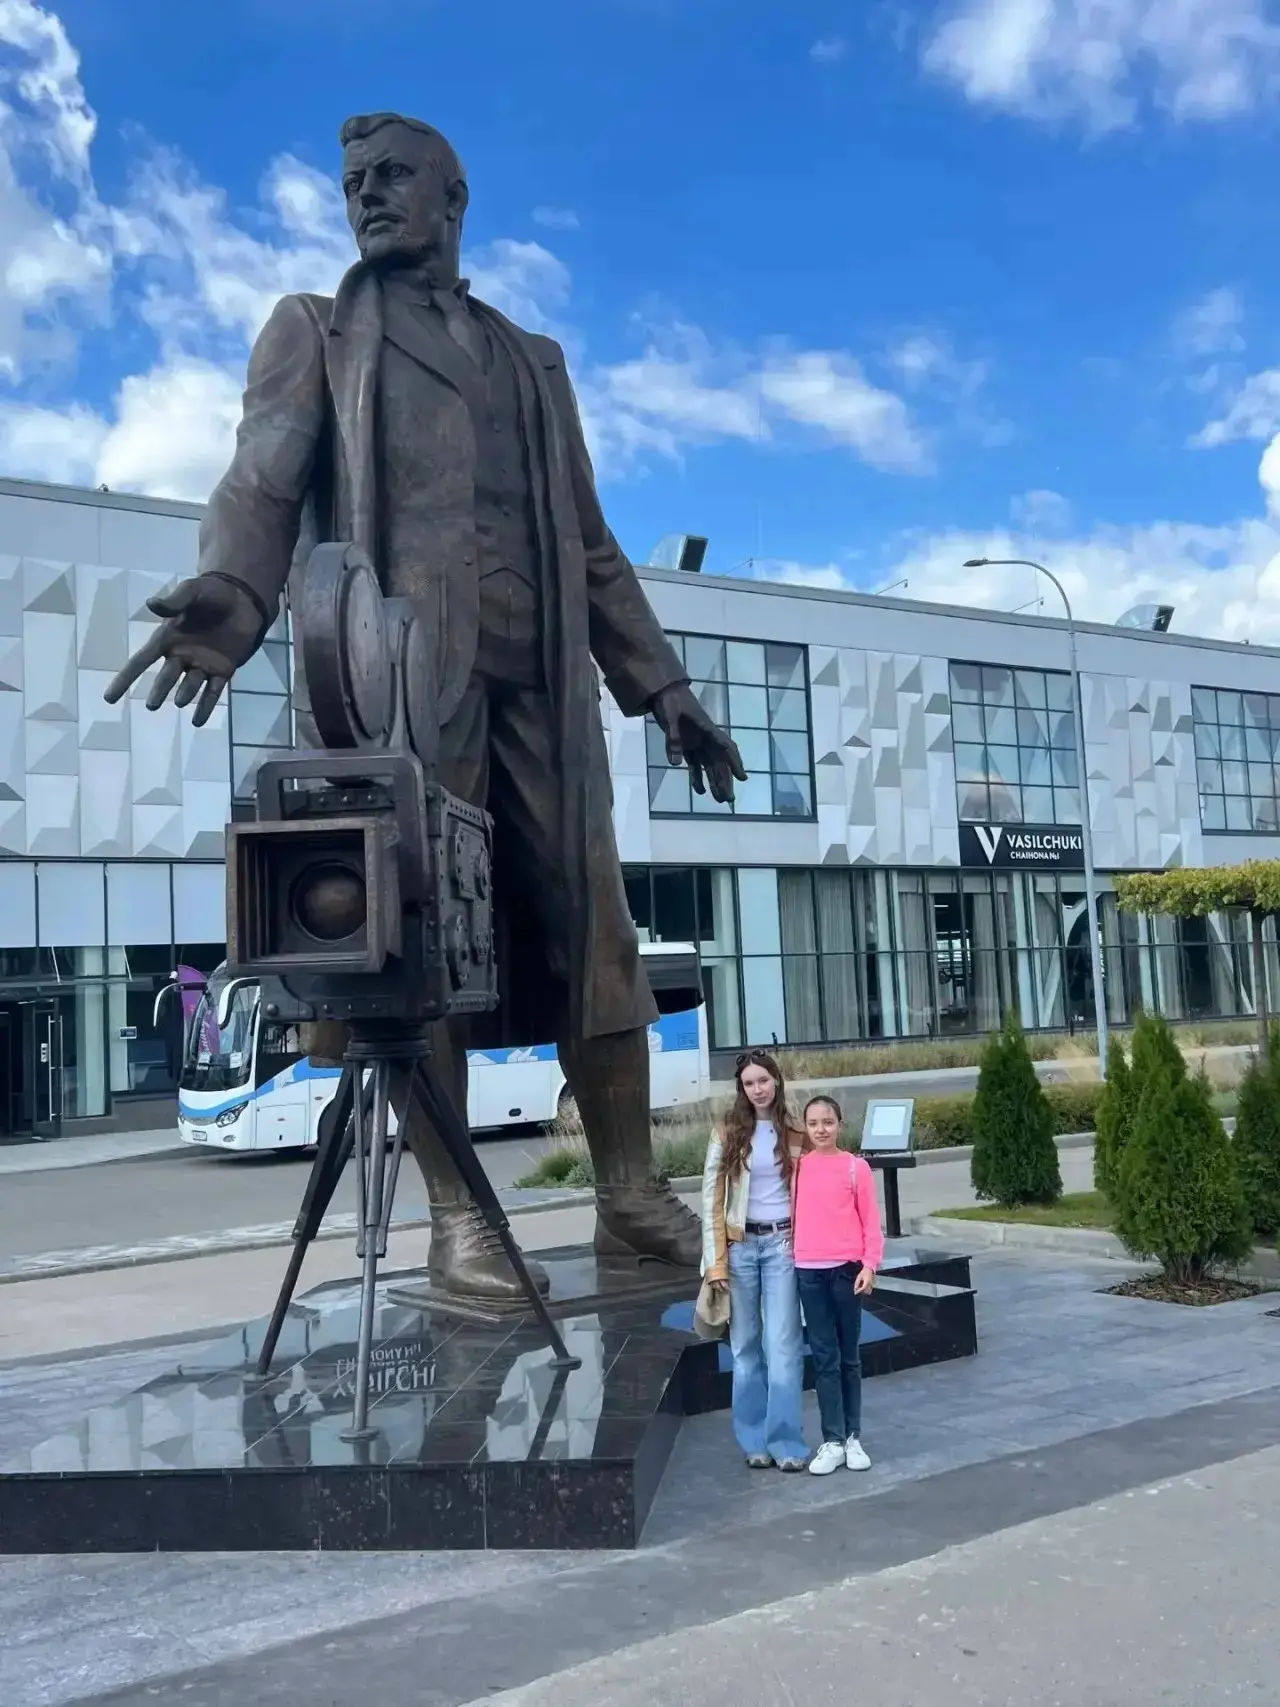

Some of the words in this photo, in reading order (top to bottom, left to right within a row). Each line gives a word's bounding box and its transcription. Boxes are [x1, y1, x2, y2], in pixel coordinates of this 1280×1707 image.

[974, 827, 1003, 864] V
[1006, 834, 1082, 850] VASILCHUKI
[1010, 851, 1049, 860] CHAIHONA
